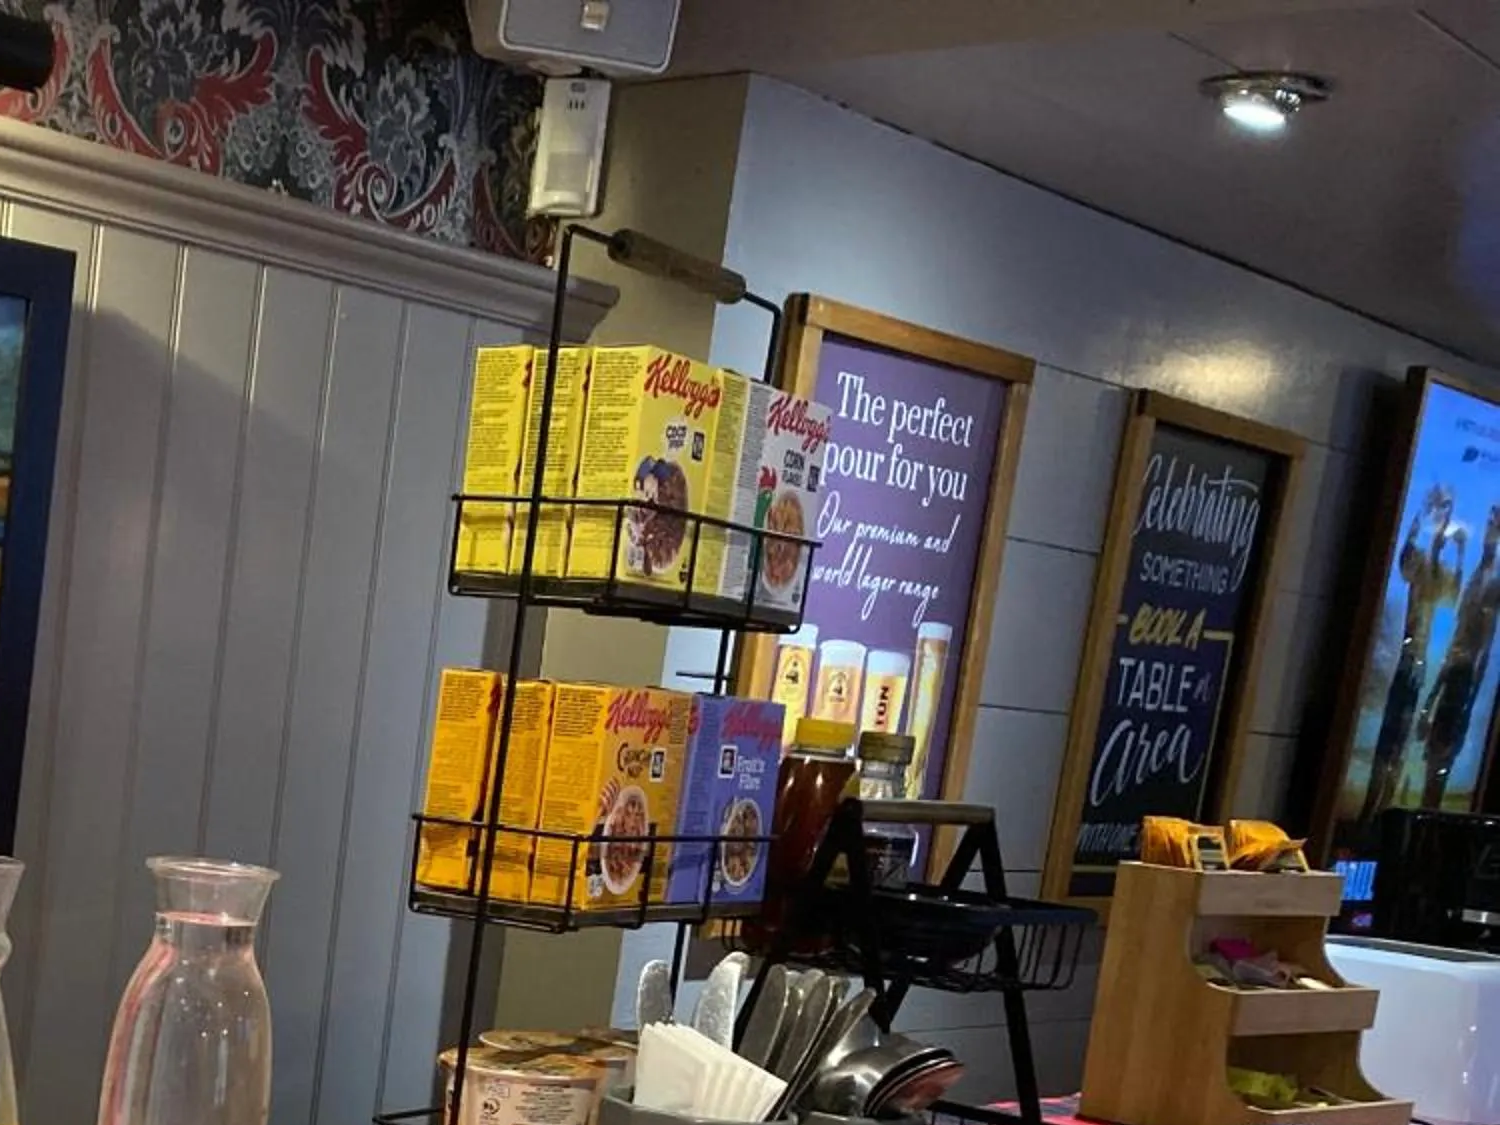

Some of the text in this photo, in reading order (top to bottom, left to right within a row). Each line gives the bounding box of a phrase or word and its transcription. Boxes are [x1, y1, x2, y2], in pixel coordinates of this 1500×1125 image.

[644, 354, 720, 418] Kellogg's
[837, 371, 974, 448] The perfect
[820, 442, 969, 507] pour for you
[817, 490, 961, 553] Our premium and
[1131, 453, 1261, 592] Celebrating
[811, 537, 940, 628] world lager range
[1140, 551, 1229, 595] SOMETHING
[1129, 602, 1206, 650] BOOK A
[1117, 656, 1196, 713] TABLE
